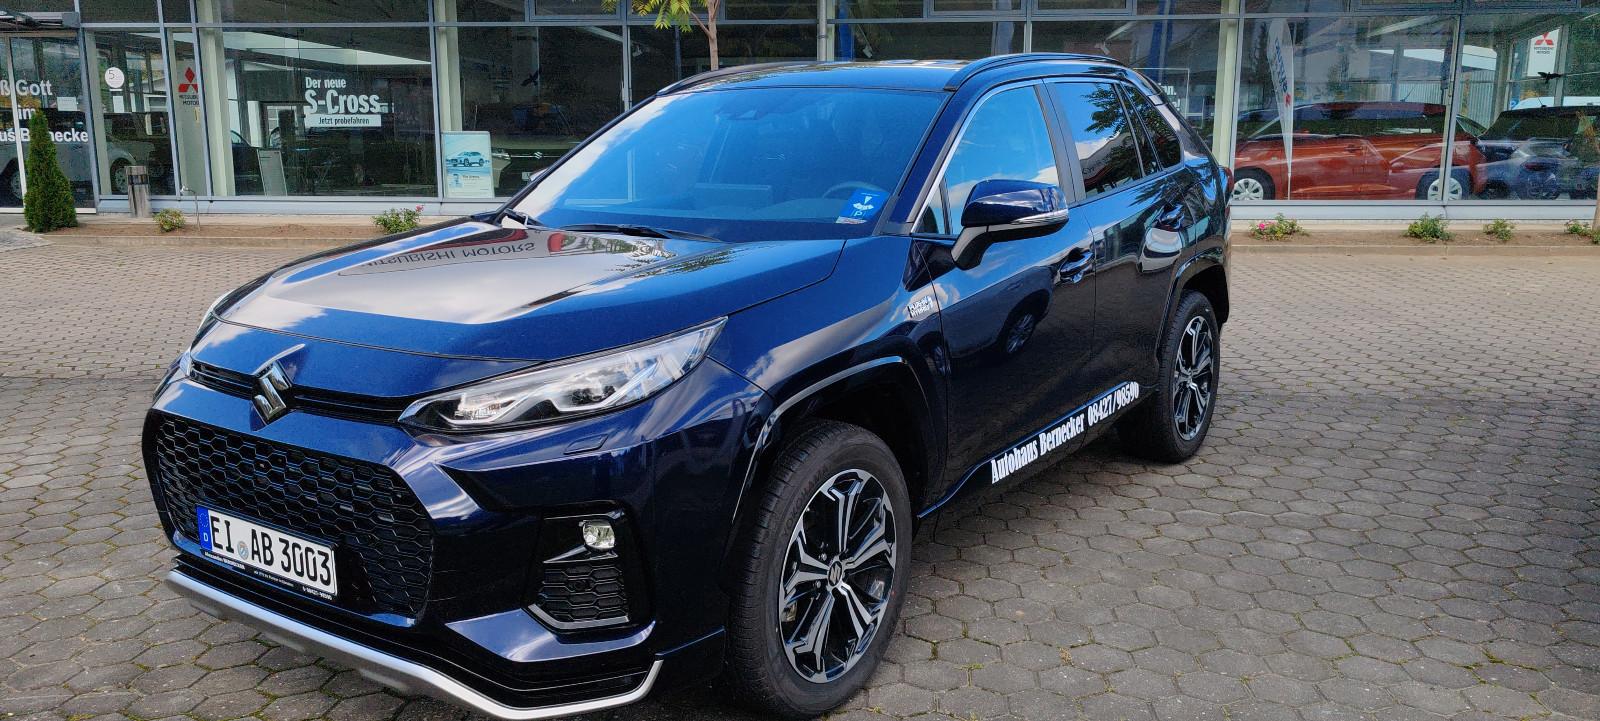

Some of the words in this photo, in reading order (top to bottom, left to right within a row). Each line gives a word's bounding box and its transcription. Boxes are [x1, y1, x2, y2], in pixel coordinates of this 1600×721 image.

[16, 79, 53, 96] Gott
[305, 76, 321, 89] Der
[324, 78, 347, 89] neue
[305, 90, 380, 114] S-Cross
[318, 116, 333, 125] Jetzt
[334, 116, 370, 126] probefahren
[990, 439, 1039, 484] Autohaus
[1038, 413, 1085, 456] Bernecker
[1087, 381, 1139, 427] 08427/98590
[203, 532, 209, 542] D
[210, 515, 235, 554] EI
[251, 528, 275, 567] AB
[279, 537, 331, 586] 3003
